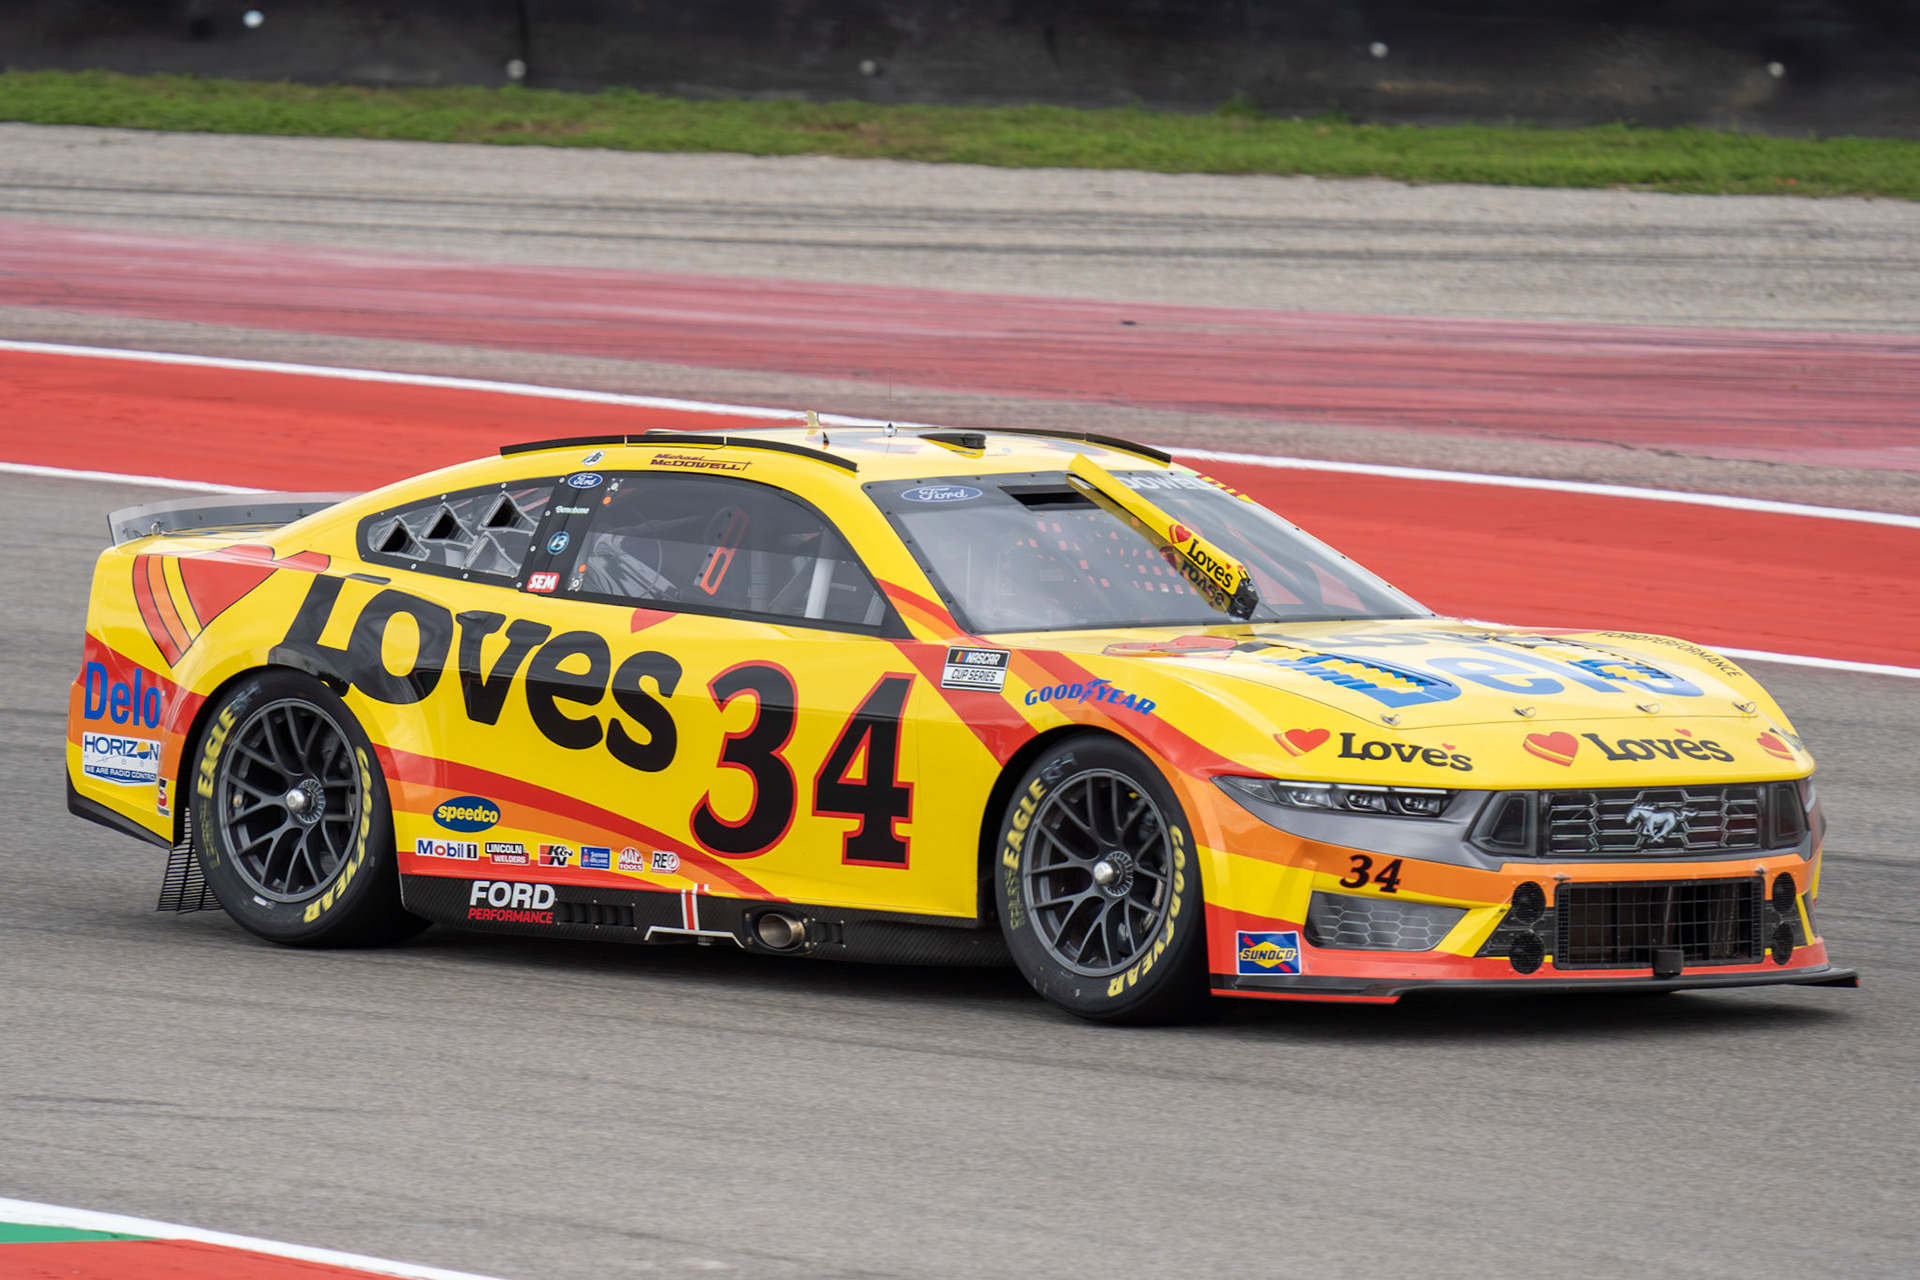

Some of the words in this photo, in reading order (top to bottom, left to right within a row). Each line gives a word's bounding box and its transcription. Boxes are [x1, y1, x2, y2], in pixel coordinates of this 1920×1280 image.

[572, 474, 599, 486] Ford
[917, 486, 970, 501] Ford
[528, 574, 558, 590] SEM
[963, 651, 1002, 666] NASCAR
[1646, 635, 1743, 677] PERFORMANCE
[951, 668, 970, 680] CUP
[967, 669, 998, 682] SERIES
[84, 661, 162, 729] Delo
[1024, 679, 1157, 716] GOODYEAR
[84, 735, 160, 762] HORIZON
[197, 705, 237, 800] EAGLE
[95, 766, 110, 776] ARE
[110, 769, 131, 778] RADIO
[688, 658, 916, 871] 34
[436, 804, 499, 824] speedco
[1002, 777, 1048, 870] EAGLE
[303, 745, 373, 924] GOODYEAR
[417, 839, 464, 858] Mobil
[466, 844, 478, 859] 1
[486, 843, 523, 855] LINCOLN
[619, 849, 642, 864] MAC
[493, 854, 527, 865] WELDERS
[619, 863, 643, 871] TOOLS
[1339, 854, 1404, 894] 34
[469, 880, 556, 910] FORD
[467, 907, 554, 924] PERFORMANCE
[1106, 824, 1187, 998] GOODYEAR
[1241, 949, 1295, 961] SUNOCO
